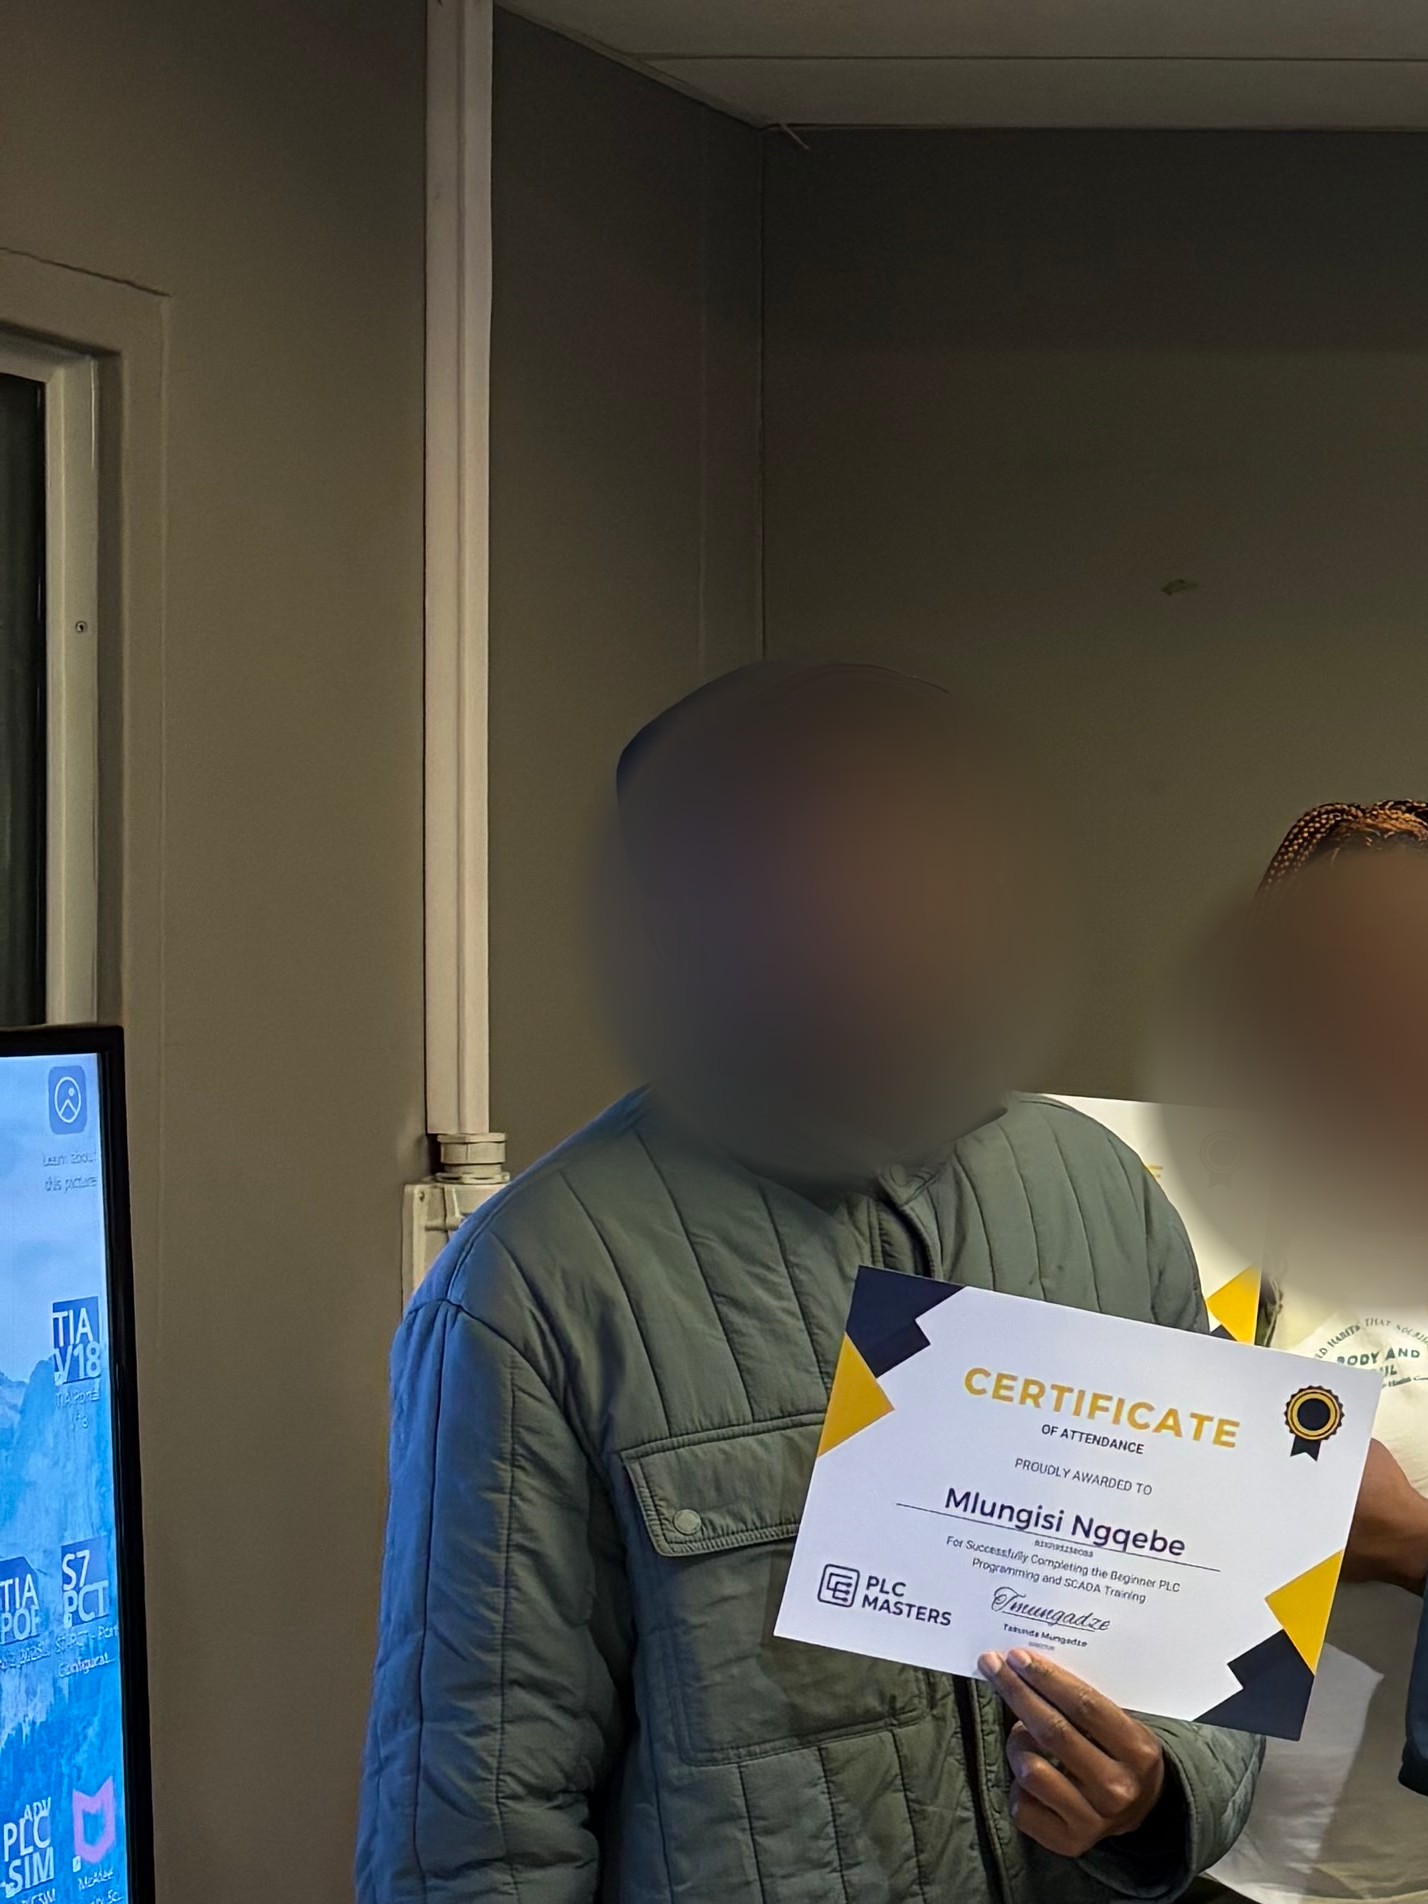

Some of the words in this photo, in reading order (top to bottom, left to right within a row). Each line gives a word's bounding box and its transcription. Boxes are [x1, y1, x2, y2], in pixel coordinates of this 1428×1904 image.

[52, 1307, 94, 1348] TIA
[54, 1341, 101, 1383] V18
[1384, 1347, 1420, 1361] AND
[963, 1366, 1240, 1449] CERTIFICATE
[1042, 1424, 1058, 1435] OF
[1060, 1428, 1144, 1454] ATTENDANCE
[1015, 1458, 1071, 1478] PROUDLY
[1072, 1471, 1132, 1491] AWARDED
[1136, 1483, 1152, 1495] TO
[943, 1488, 1065, 1533] Mlungisi
[1070, 1515, 1186, 1559] Ngqebe
[62, 1549, 90, 1591] S7
[946, 1536, 963, 1548] For
[1031, 1554, 1088, 1576] Completing
[1091, 1567, 1108, 1578] the
[1159, 1580, 1180, 1592] PLC
[972, 1557, 1040, 1583] Programming
[1042, 1575, 1062, 1585] and
[1105, 1586, 1146, 1604] Training
[0, 1573, 39, 1612] TIA
[63, 1579, 109, 1621] PCT
[866, 1575, 906, 1597] PLC
[862, 1594, 951, 1626] MASTERS
[3, 1814, 51, 1862] PLC
